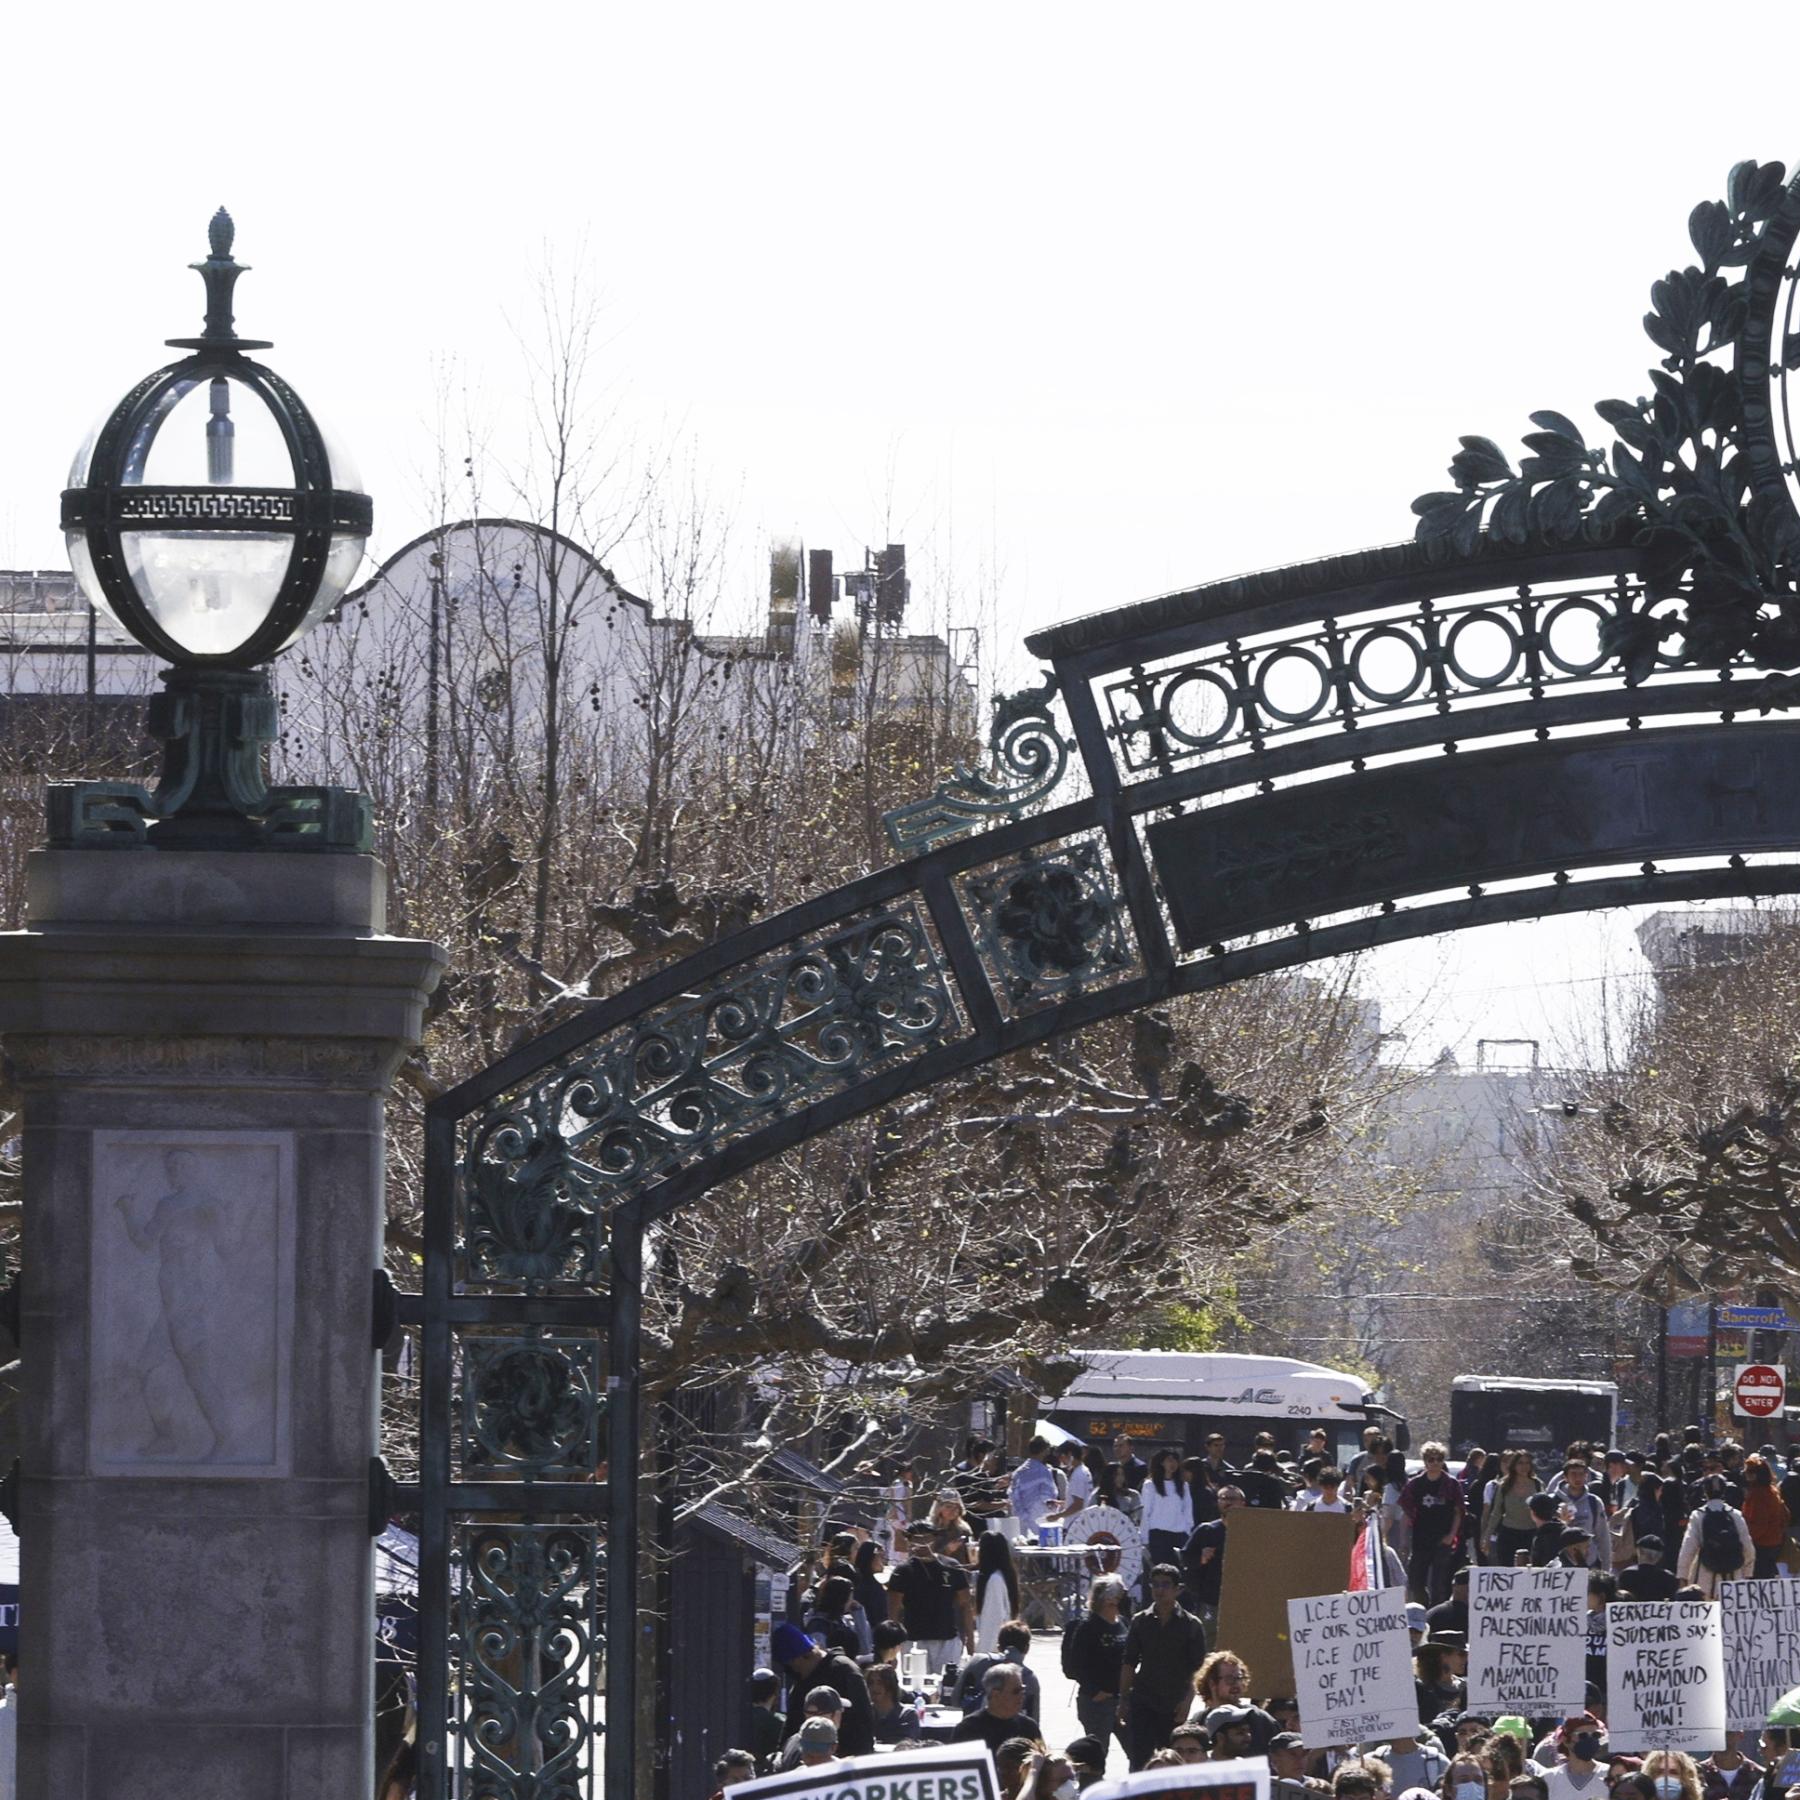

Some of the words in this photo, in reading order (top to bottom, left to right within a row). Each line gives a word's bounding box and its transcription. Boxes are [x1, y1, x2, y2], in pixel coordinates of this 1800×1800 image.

[1721, 1311, 1780, 1324] Bancroft
[1742, 1376, 1755, 1384] DO
[1288, 1405, 1312, 1415] 2240
[1745, 1399, 1774, 1407] ENTER
[1090, 1422, 1108, 1436] 52
[1478, 1571, 1523, 1593] FIRST
[1531, 1571, 1575, 1591] THEY
[1348, 1591, 1386, 1616] OUT
[1474, 1596, 1515, 1612] CAME
[1521, 1597, 1543, 1613] FOR
[1549, 1595, 1583, 1614] THE
[1610, 1605, 1673, 1623] BERKELEY
[1680, 1603, 1712, 1619] CITY
[1294, 1629, 1312, 1644] OF
[1322, 1624, 1350, 1640] OUR
[1355, 1614, 1408, 1639] SCHOOLS
[1722, 1609, 1757, 1635] CITY
[1613, 1626, 1681, 1646] STUDENTS
[1354, 1640, 1384, 1663] OUT
[1500, 1642, 1551, 1666] FREE
[1636, 1648, 1688, 1668] FREE
[1723, 1634, 1763, 1662] SAYS
[1319, 1672, 1338, 1689] OF
[1350, 1666, 1381, 1686] THE
[1481, 1666, 1559, 1687] MAHMOUD
[1622, 1666, 1707, 1690] MAHMOUD
[1326, 1685, 1365, 1711] BAY!
[1497, 1683, 1556, 1700] KHALIL!
[1634, 1689, 1687, 1712] KHALIL
[1641, 1706, 1683, 1728] NOW!
